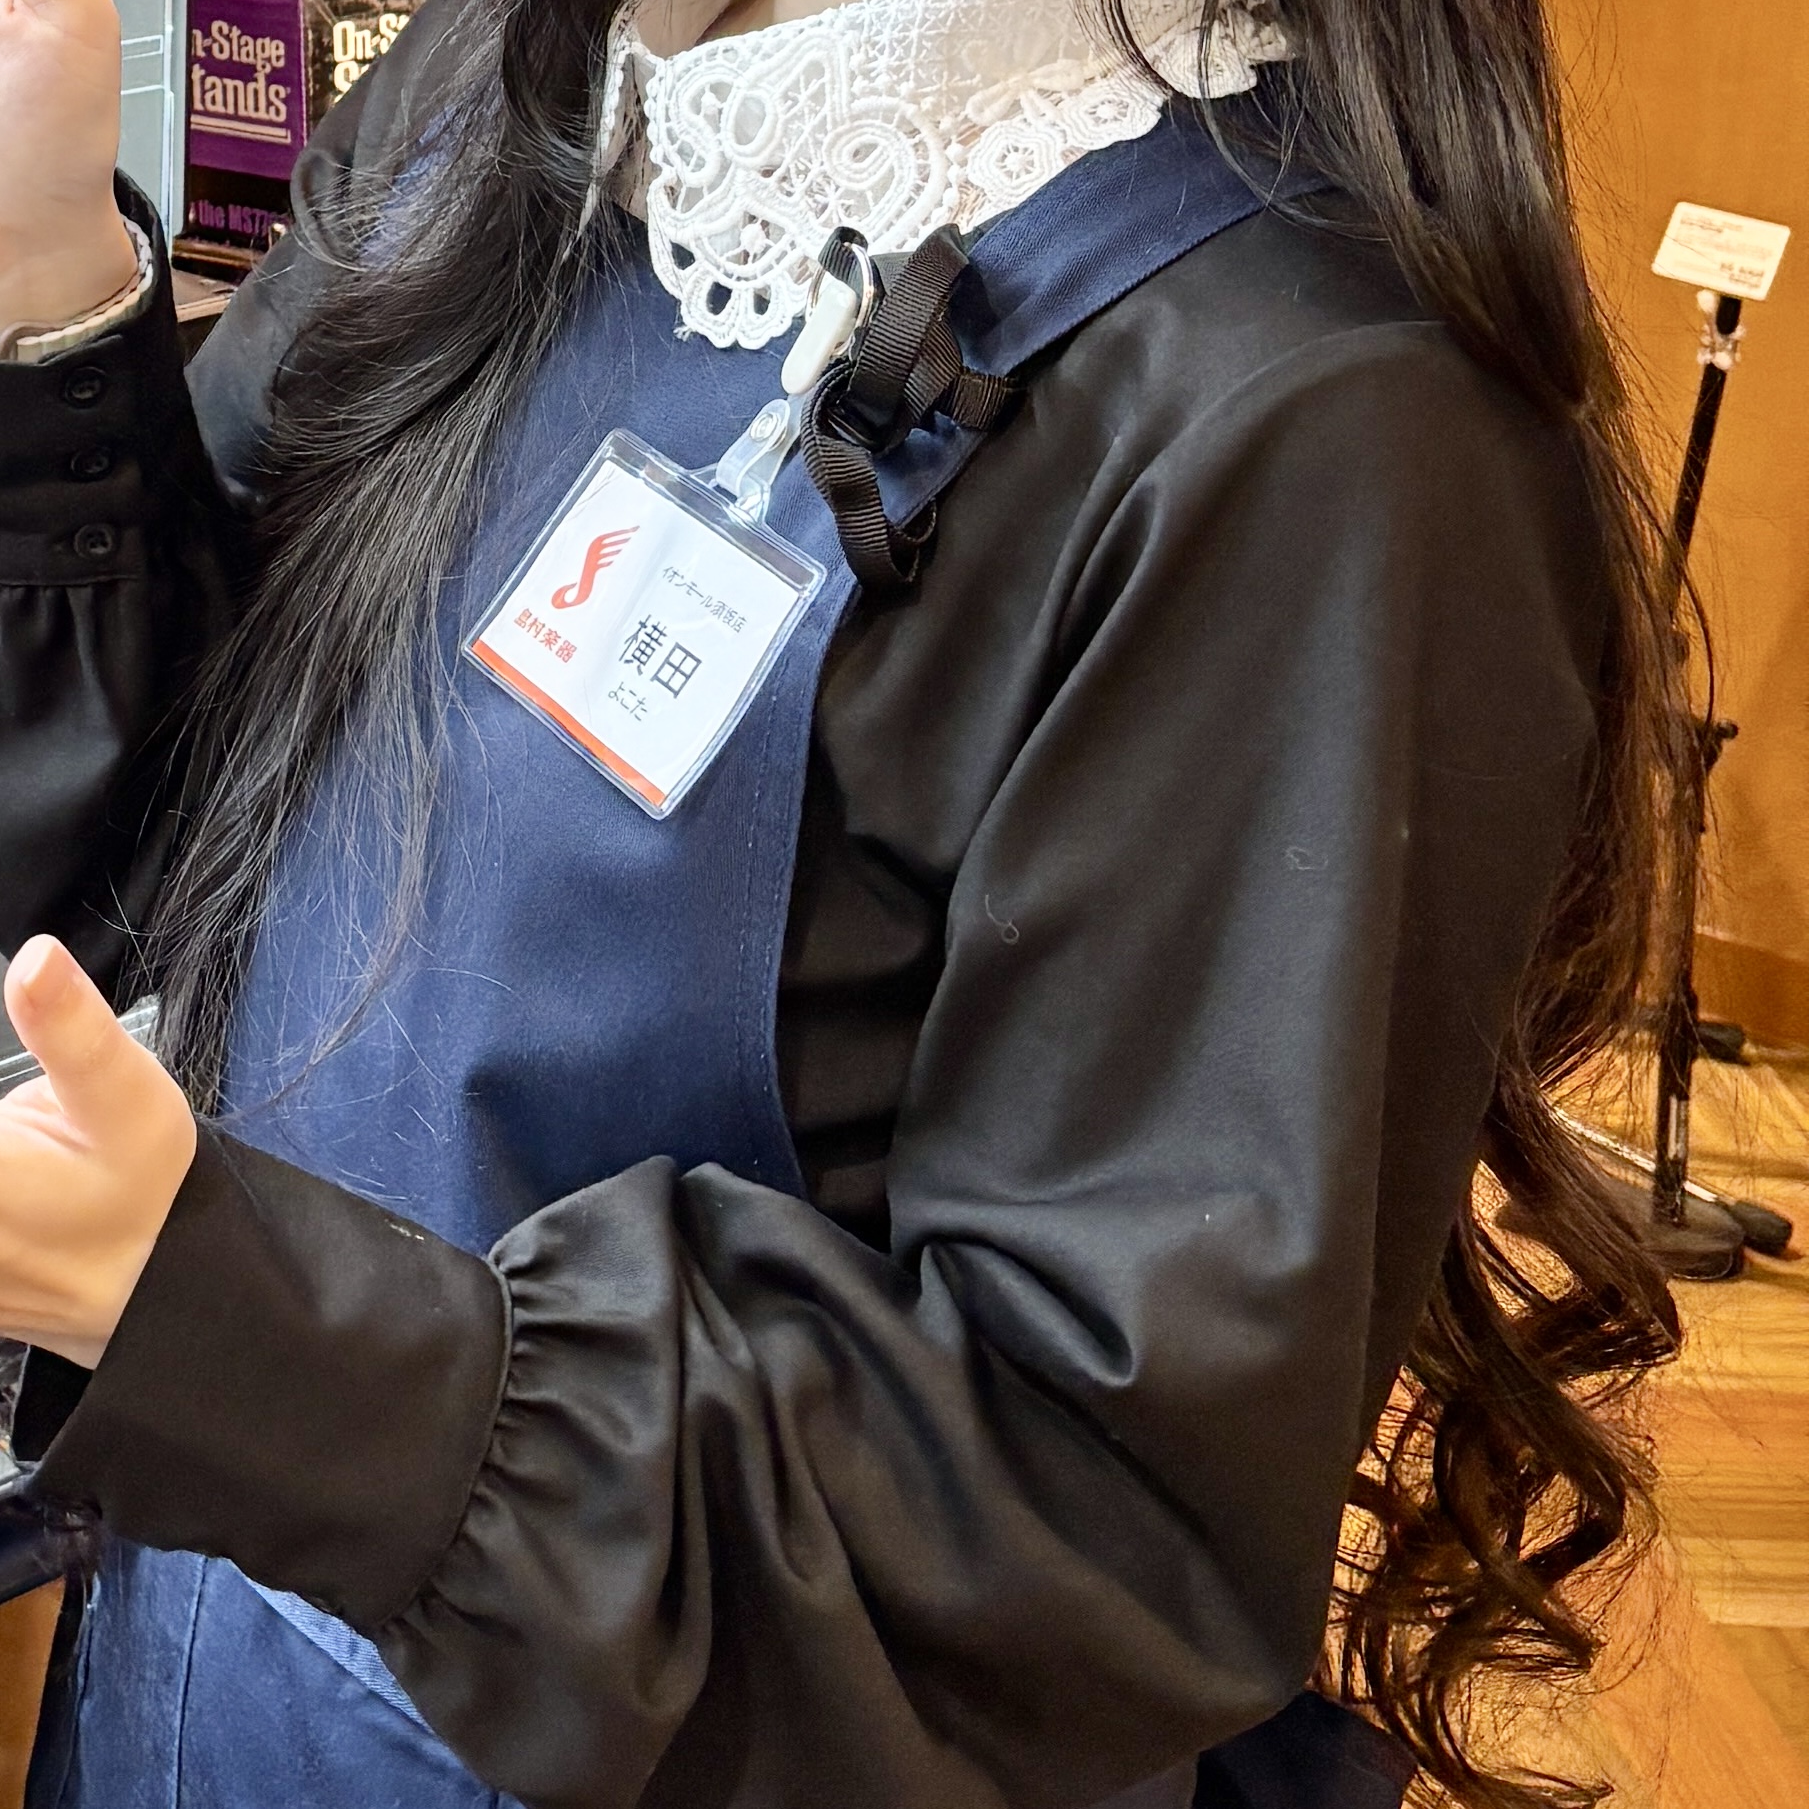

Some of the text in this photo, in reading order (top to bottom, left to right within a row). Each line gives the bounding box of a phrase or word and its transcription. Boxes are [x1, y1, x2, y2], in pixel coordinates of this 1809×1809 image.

[514, 608, 577, 664] 島村楽器
[618, 614, 703, 700] 横田
[608, 682, 648, 722] よこた
